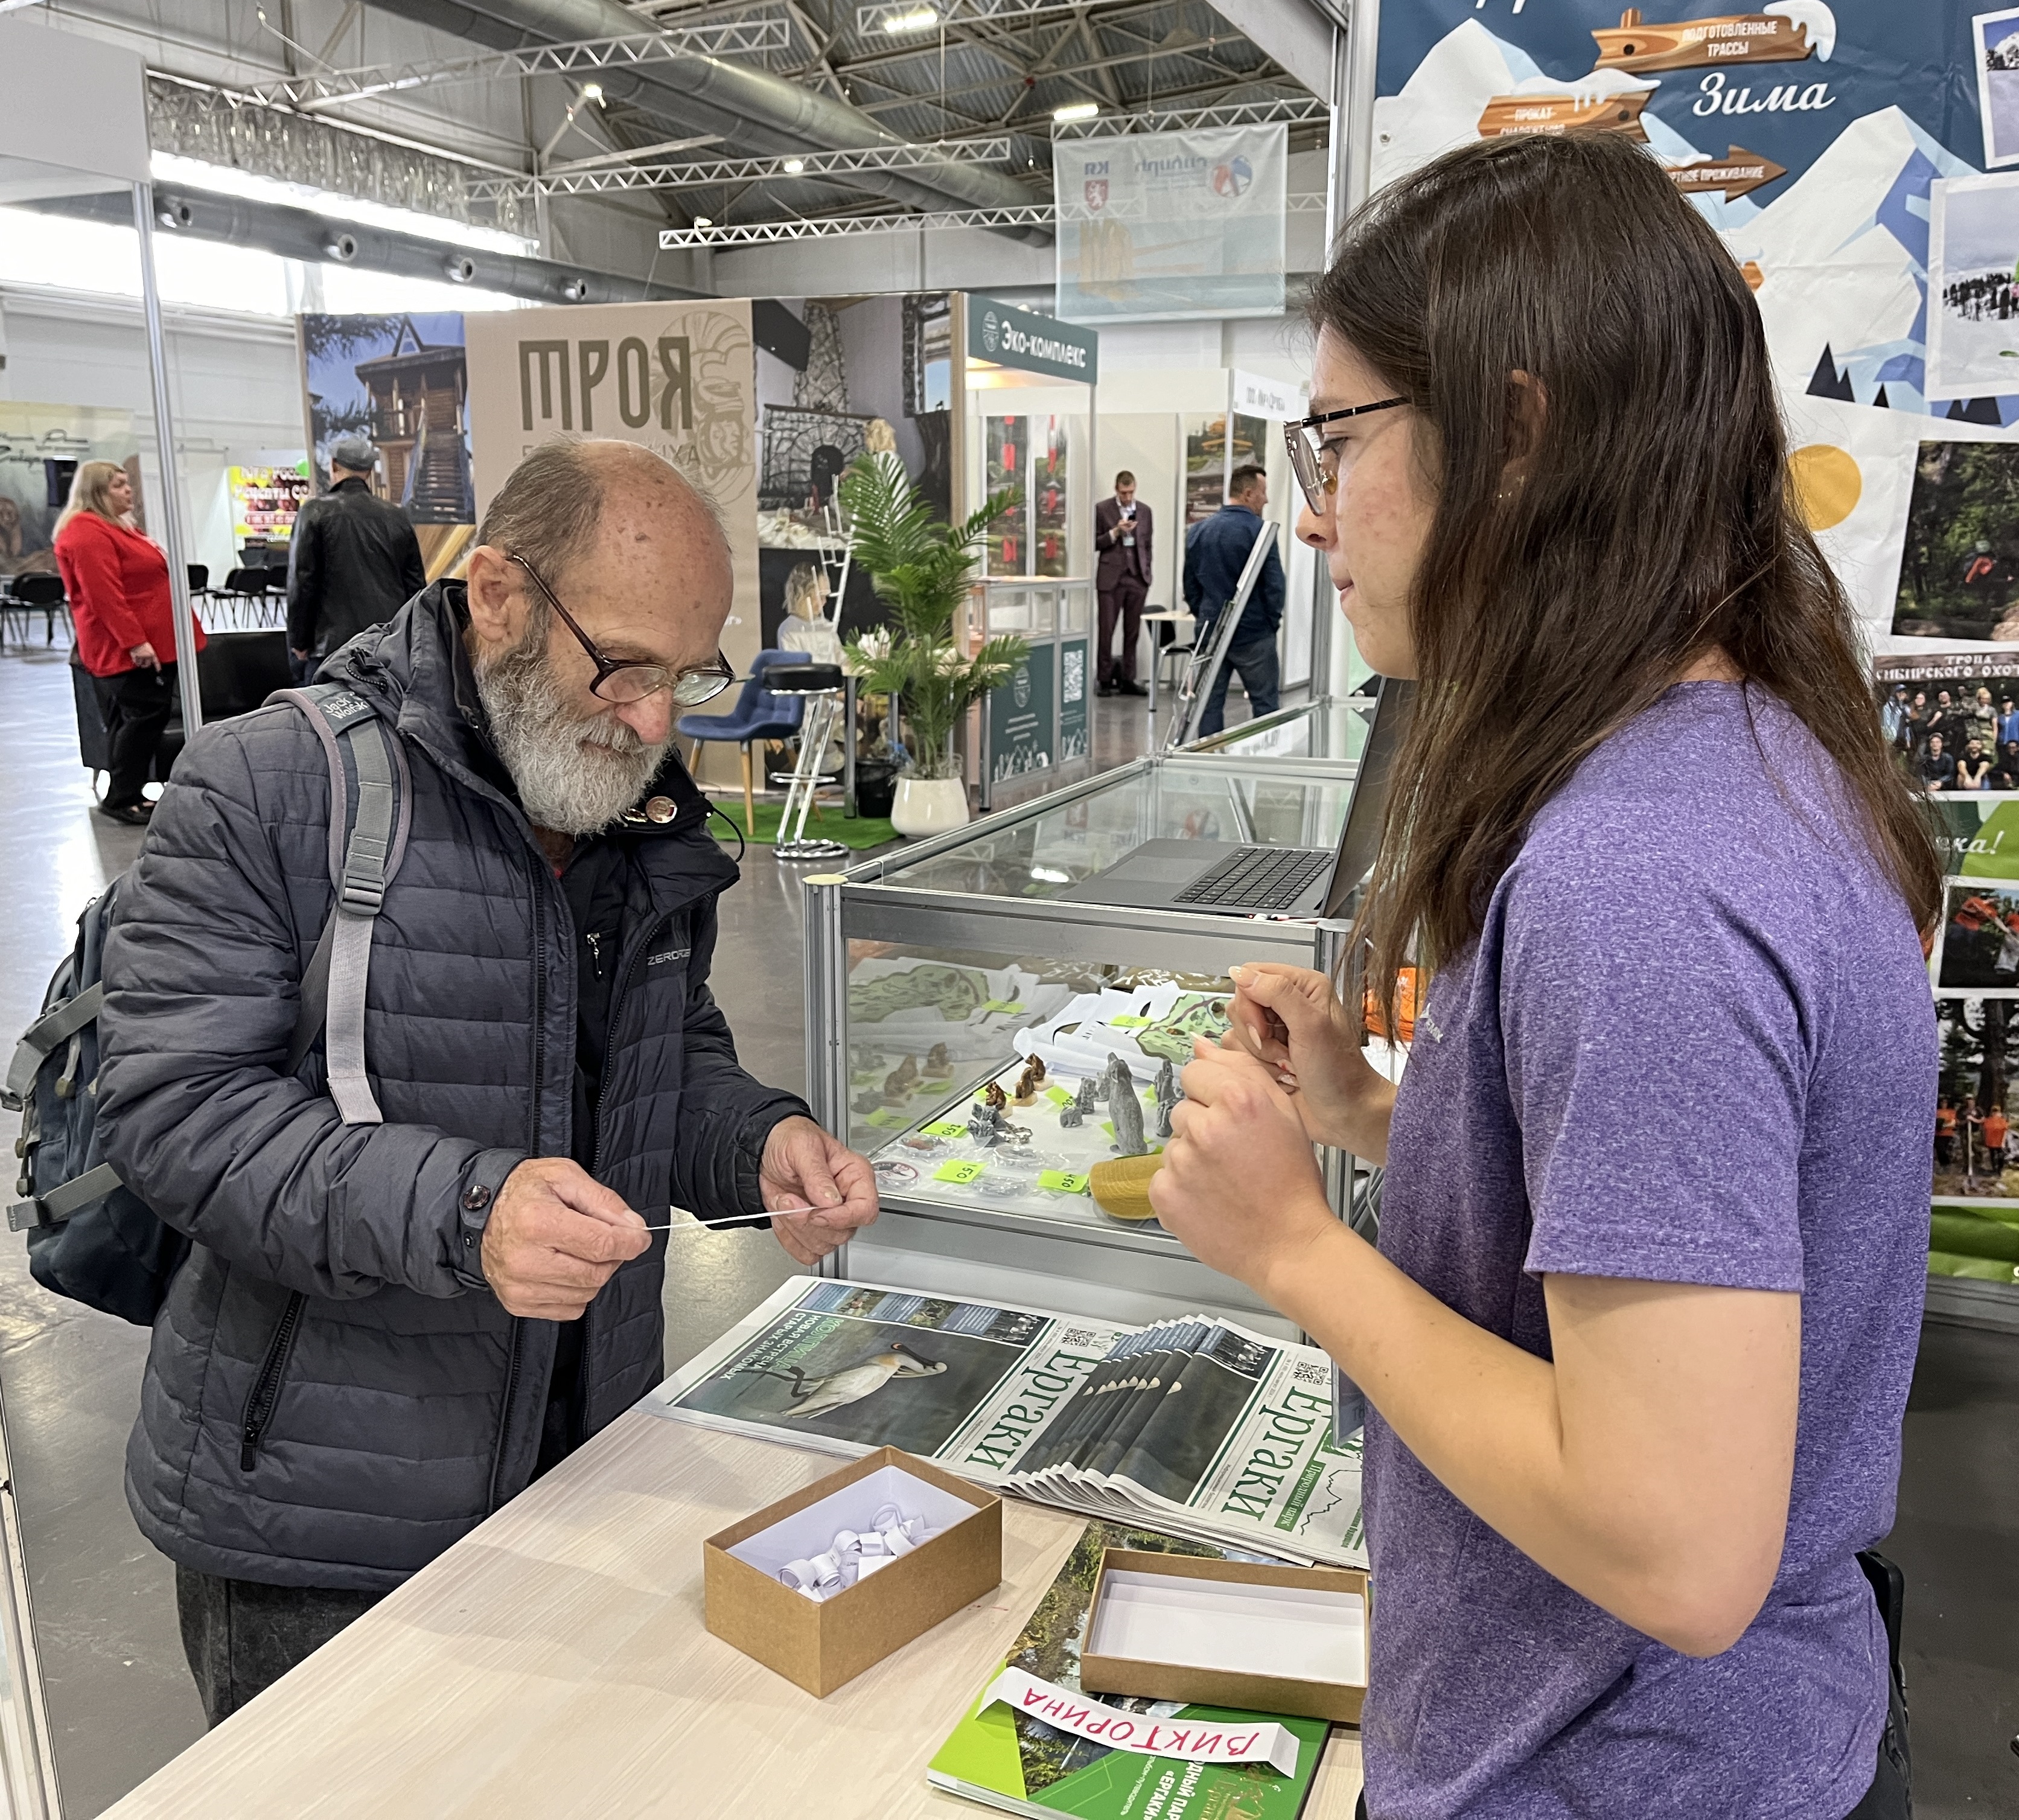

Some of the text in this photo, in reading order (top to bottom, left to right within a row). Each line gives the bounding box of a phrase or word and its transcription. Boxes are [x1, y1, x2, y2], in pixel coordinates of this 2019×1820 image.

[1682, 21, 1778, 42] ПОДГОТОВЛЕННЫЕ
[1707, 41, 1749, 57] ТРАССЫ
[1692, 72, 1836, 117] Зима
[1001, 320, 1086, 368] Эко-комплекс
[1945, 654, 1992, 665] ТРОПА
[324, 697, 351, 714] Jack
[956, 1163, 978, 1179] 150
[1061, 1173, 1076, 1188] 450
[719, 1312, 806, 1381] СТАРЫХ ЗНАКОМЫХ
[754, 1315, 821, 1370] НОВАЯ ВСТРЕЧА
[964, 1350, 1101, 1471] Ергаки
[1220, 1386, 1332, 1521] Ергаки
[1281, 1464, 1322, 1527] Природный парк
[1023, 1688, 1260, 1755] ВИКТОРИНА
[1165, 1797, 1188, 1820] ПАР
